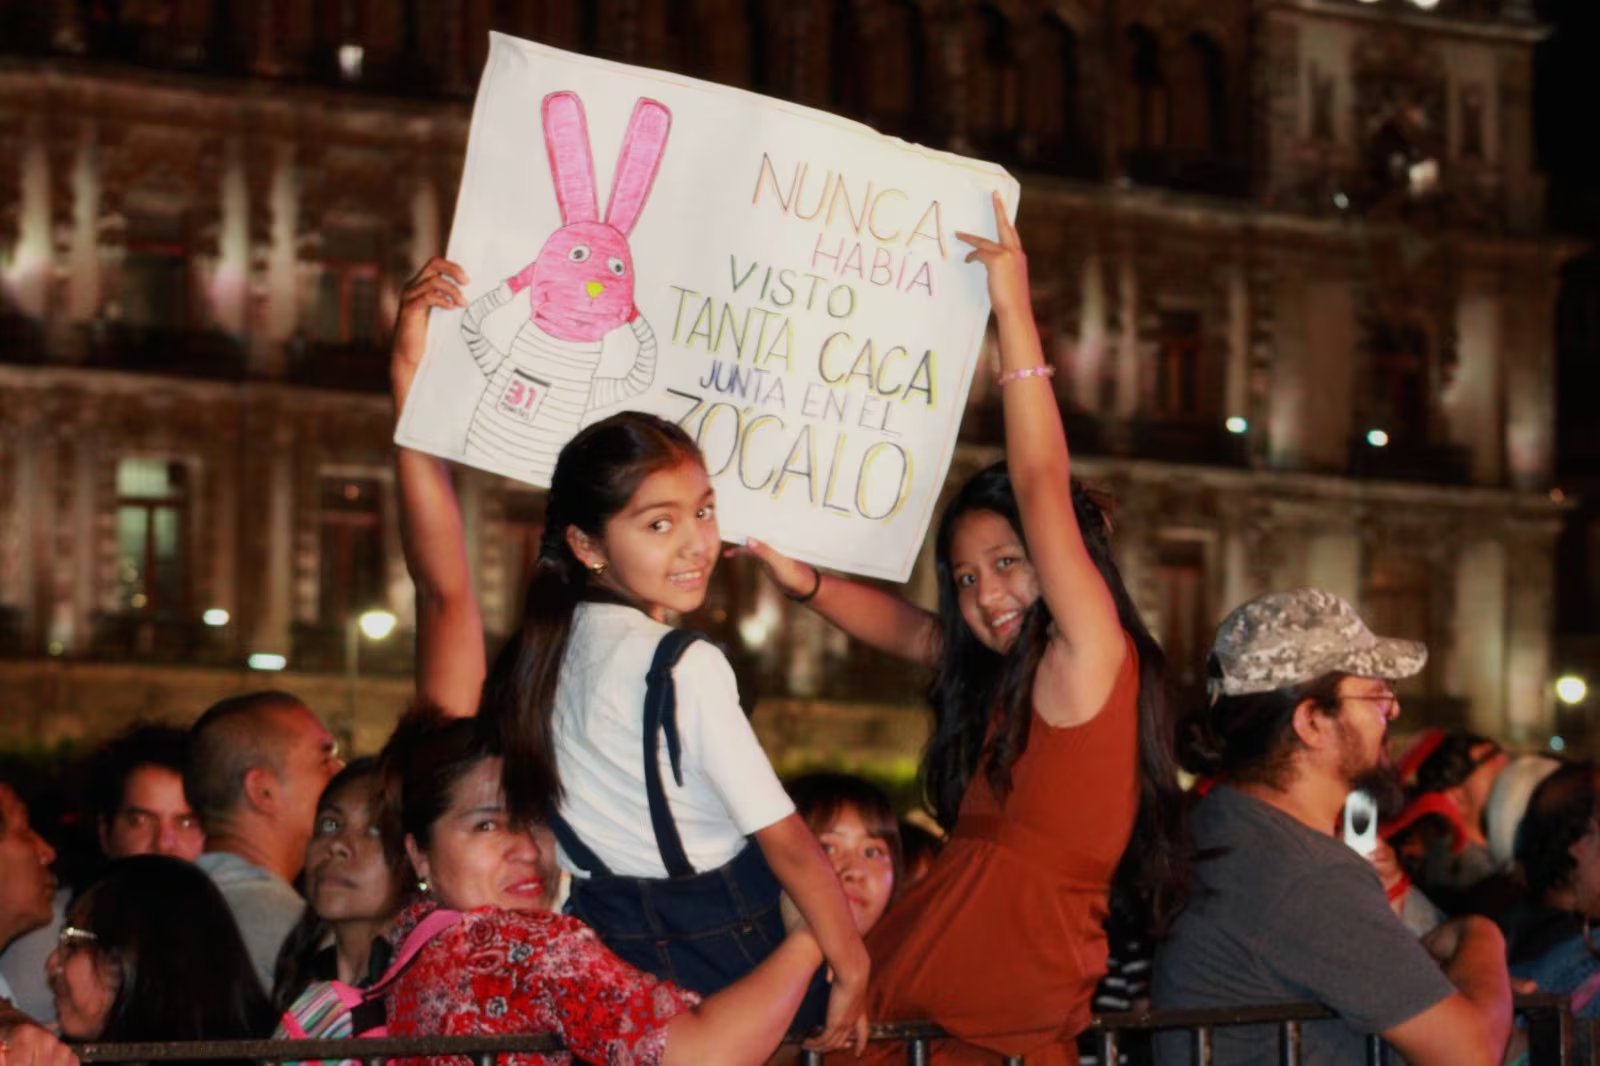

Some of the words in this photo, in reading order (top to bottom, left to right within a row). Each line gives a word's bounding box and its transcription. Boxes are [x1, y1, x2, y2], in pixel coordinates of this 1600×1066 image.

[751, 150, 946, 258] NUNCA
[730, 253, 858, 319] VISTO
[669, 284, 794, 373] TANTA
[817, 331, 937, 409] CACA
[504, 379, 539, 410] 31
[699, 359, 786, 408] JUNTA
[801, 381, 848, 423] EN
[857, 394, 901, 436] EL
